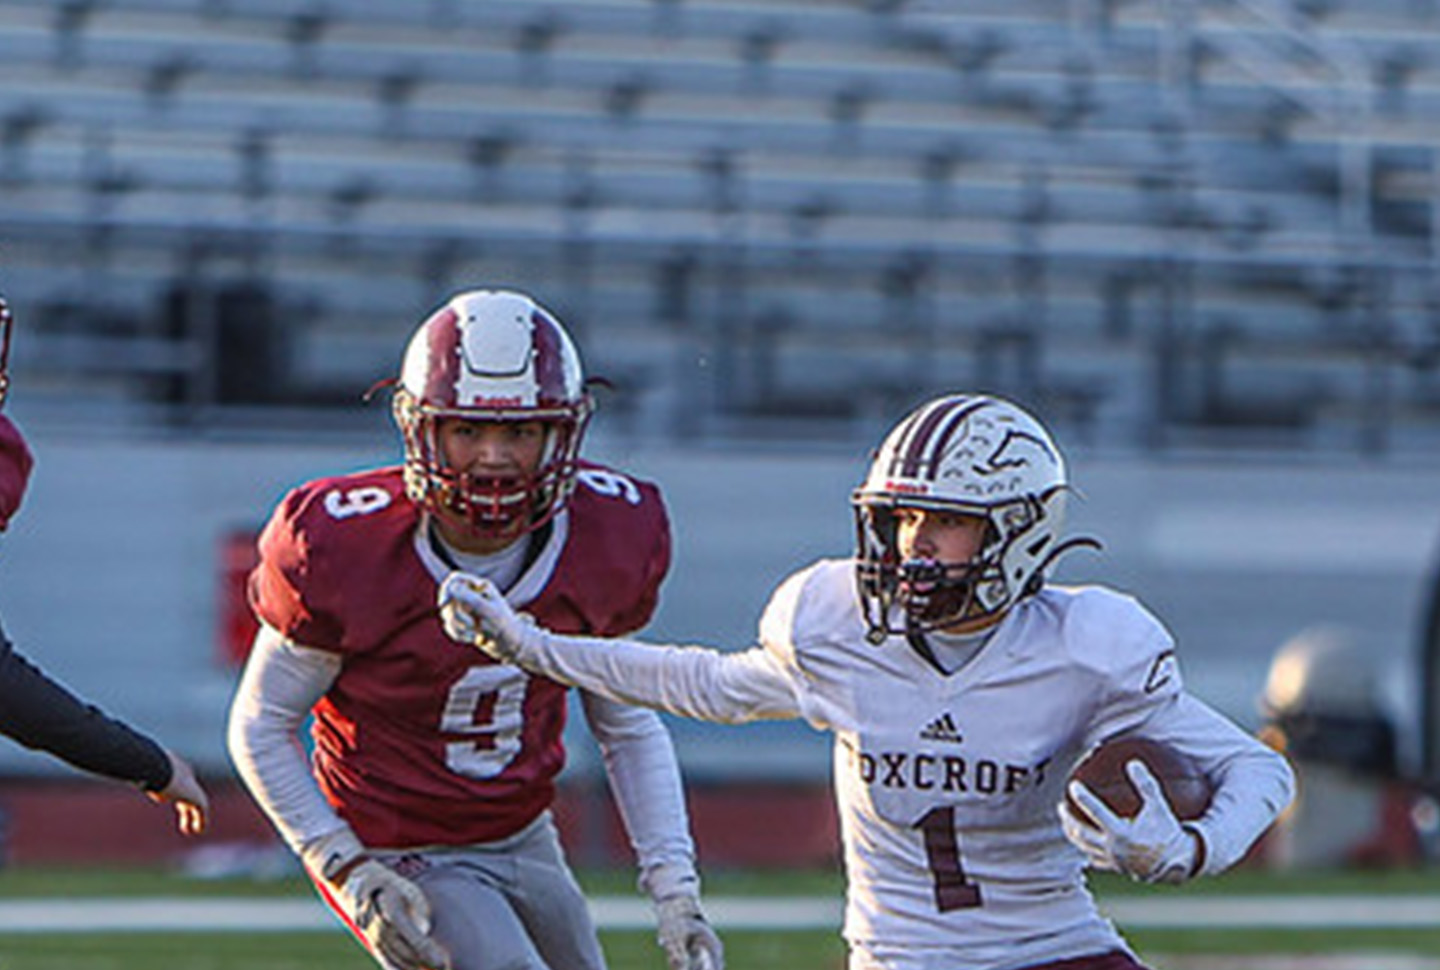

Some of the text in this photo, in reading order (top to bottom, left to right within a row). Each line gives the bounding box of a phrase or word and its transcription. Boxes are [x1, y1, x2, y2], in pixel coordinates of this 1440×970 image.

[324, 486, 391, 519] 9
[440, 663, 529, 780] 9
[841, 738, 1052, 795] OXCROFT
[912, 805, 984, 914] 1
